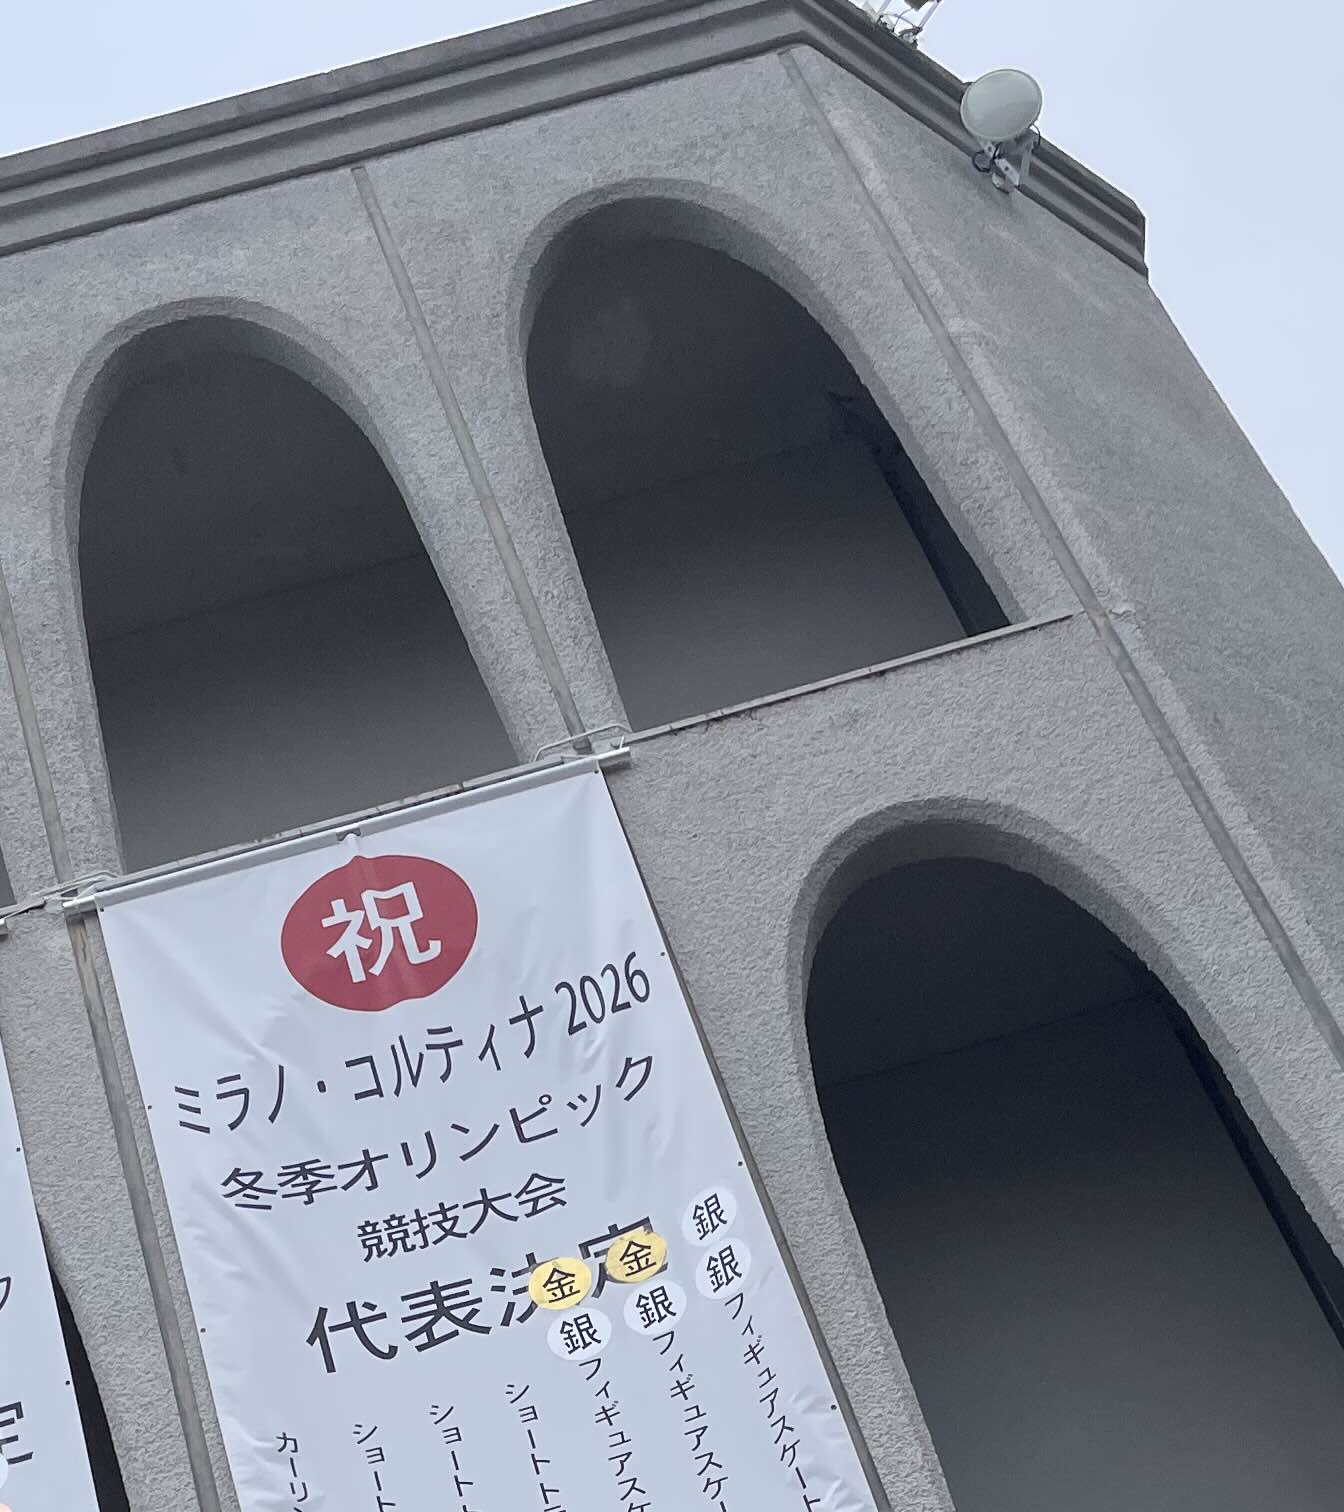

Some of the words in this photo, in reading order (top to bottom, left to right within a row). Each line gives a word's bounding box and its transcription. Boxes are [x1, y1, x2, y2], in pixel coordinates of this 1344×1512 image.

[321, 880, 443, 984] 祝
[174, 995, 544, 1134] ミラノ・コルティナ
[554, 952, 650, 1036] 2026
[220, 1056, 652, 1210] 冬季オリンピック
[357, 1173, 567, 1263] 競技大会
[692, 1193, 729, 1240] 銀
[619, 1240, 657, 1277] 金
[705, 1245, 743, 1293] 銀
[542, 1267, 581, 1304] 金
[635, 1286, 677, 1329] 銀
[559, 1314, 602, 1355] 銀
